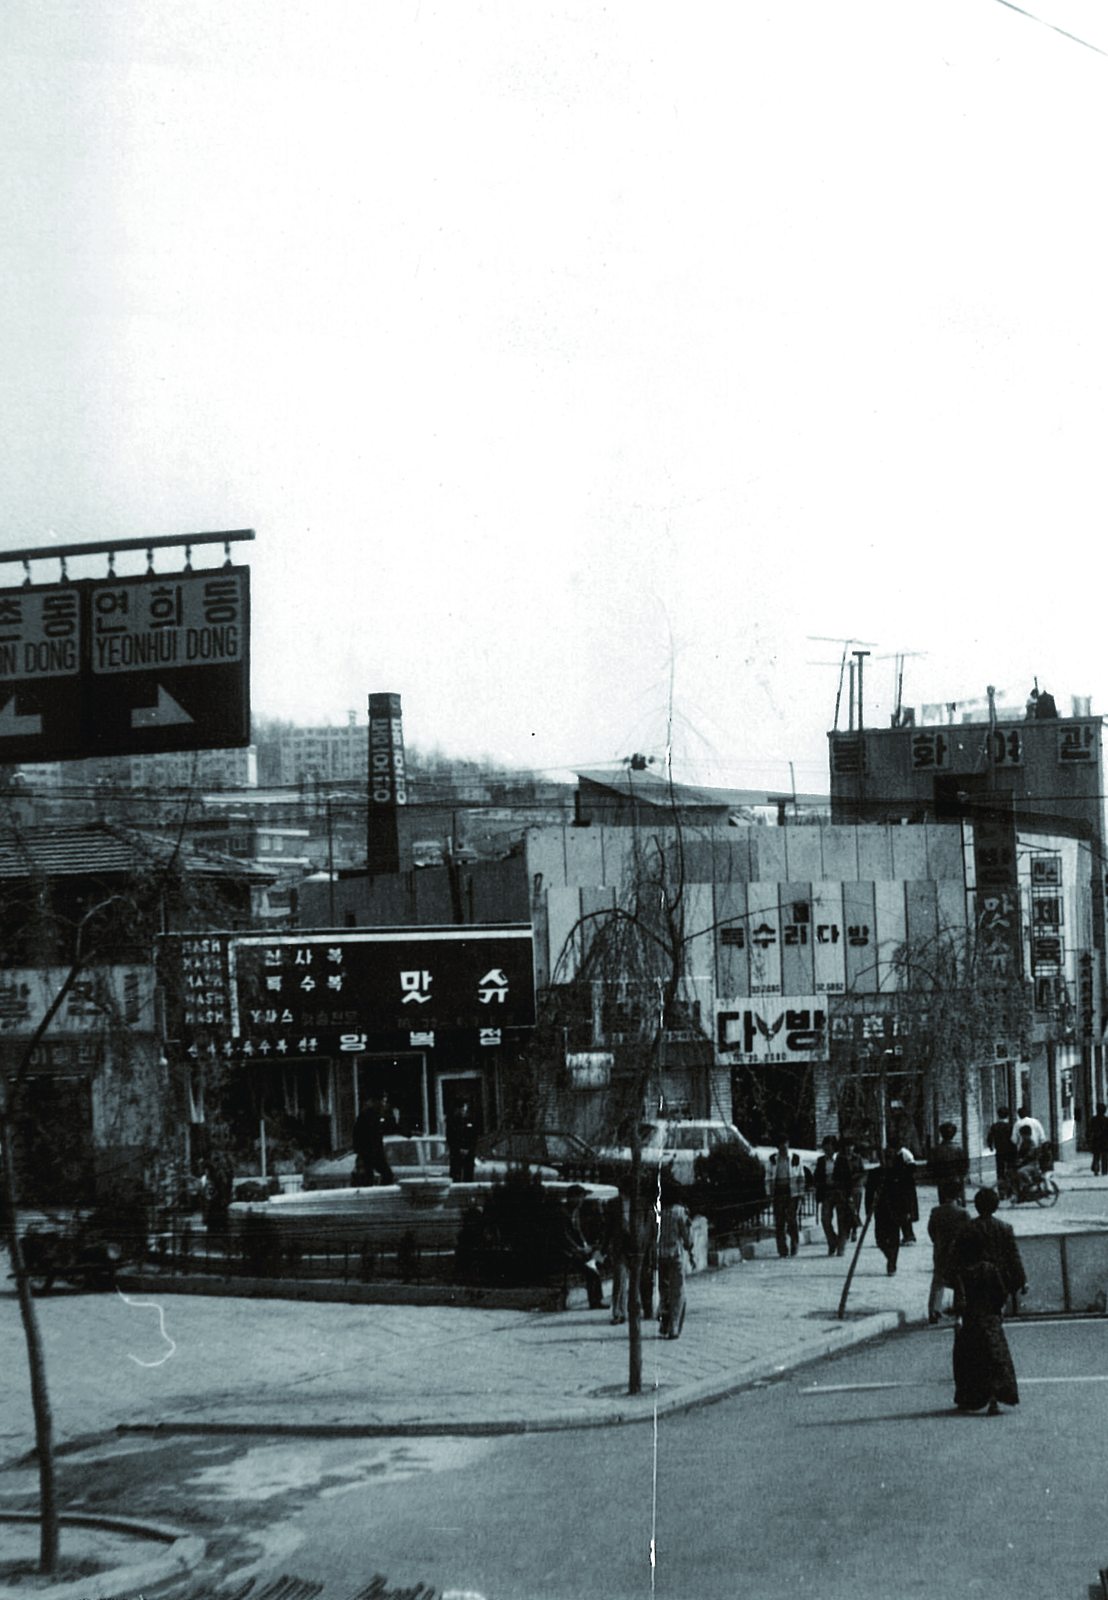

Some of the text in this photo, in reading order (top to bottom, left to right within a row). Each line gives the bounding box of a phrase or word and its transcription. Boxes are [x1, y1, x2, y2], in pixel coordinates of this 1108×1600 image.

[96, 580, 239, 633] 연희동
[24, 639, 76, 673] DONG
[96, 626, 237, 669] YEONHUI DONG
[339, 1028, 503, 1051] 양복점
[716, 1009, 826, 1053] 다방
